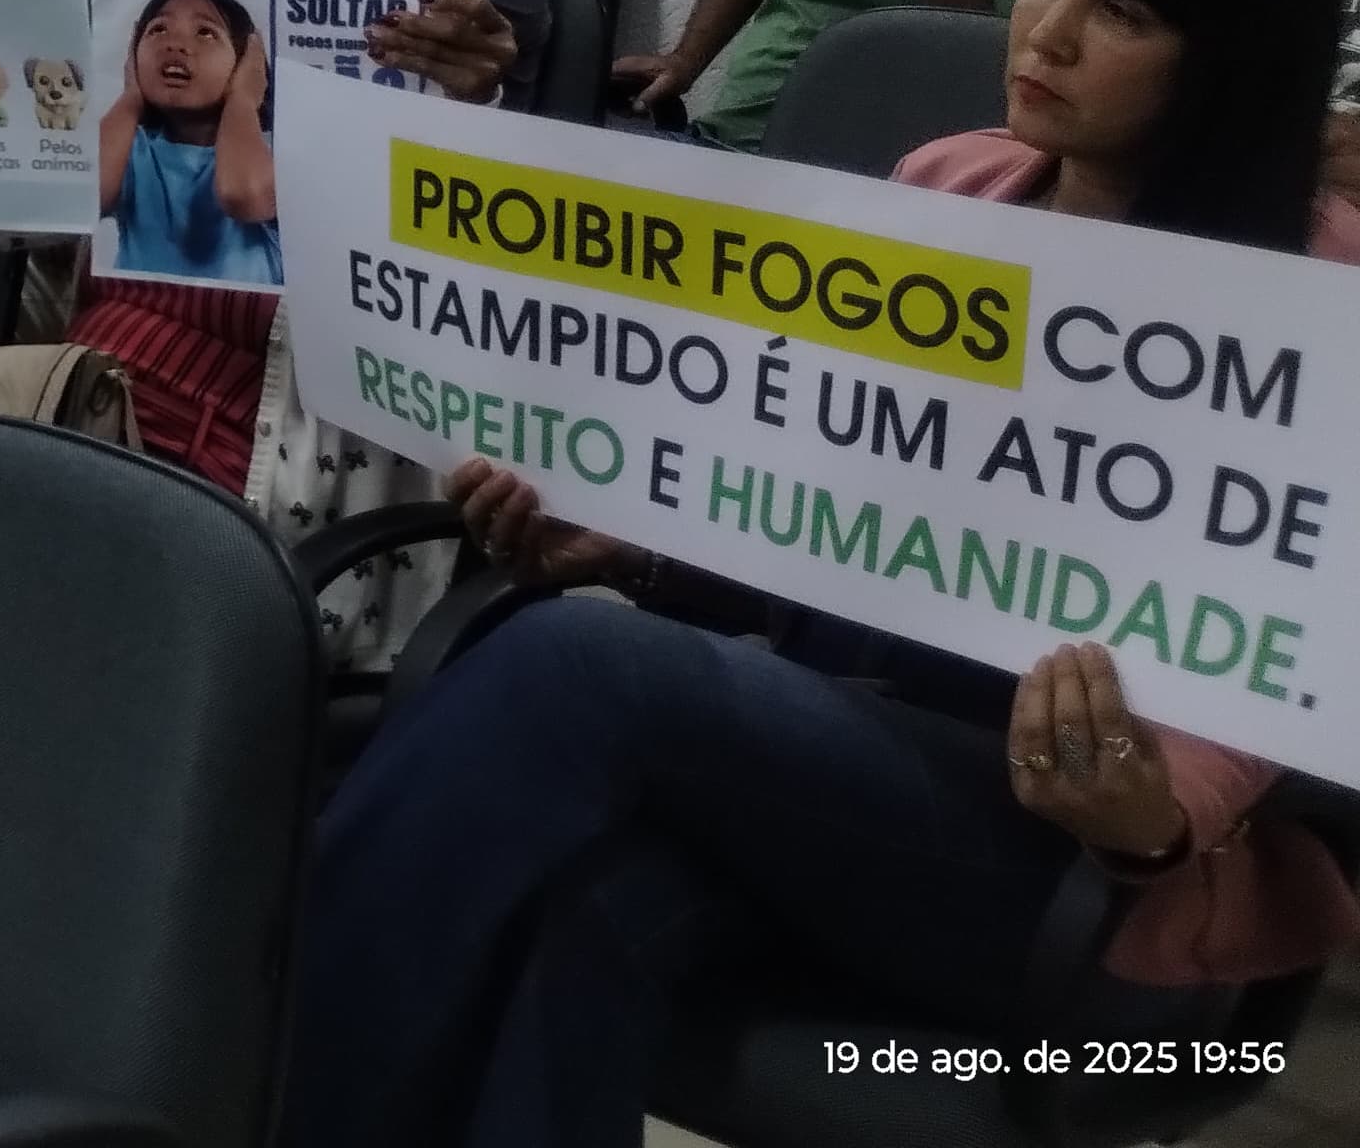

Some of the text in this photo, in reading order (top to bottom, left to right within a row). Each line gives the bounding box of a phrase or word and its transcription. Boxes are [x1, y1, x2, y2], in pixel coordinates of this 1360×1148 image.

[39, 138, 83, 156] Pelos
[348, 248, 1330, 571] ESTAMPIDO É UM ATO DE
[409, 167, 1303, 428] PROIBIR FOGOS COM
[355, 344, 1317, 711] RESPEITO E HUMANIDADE.
